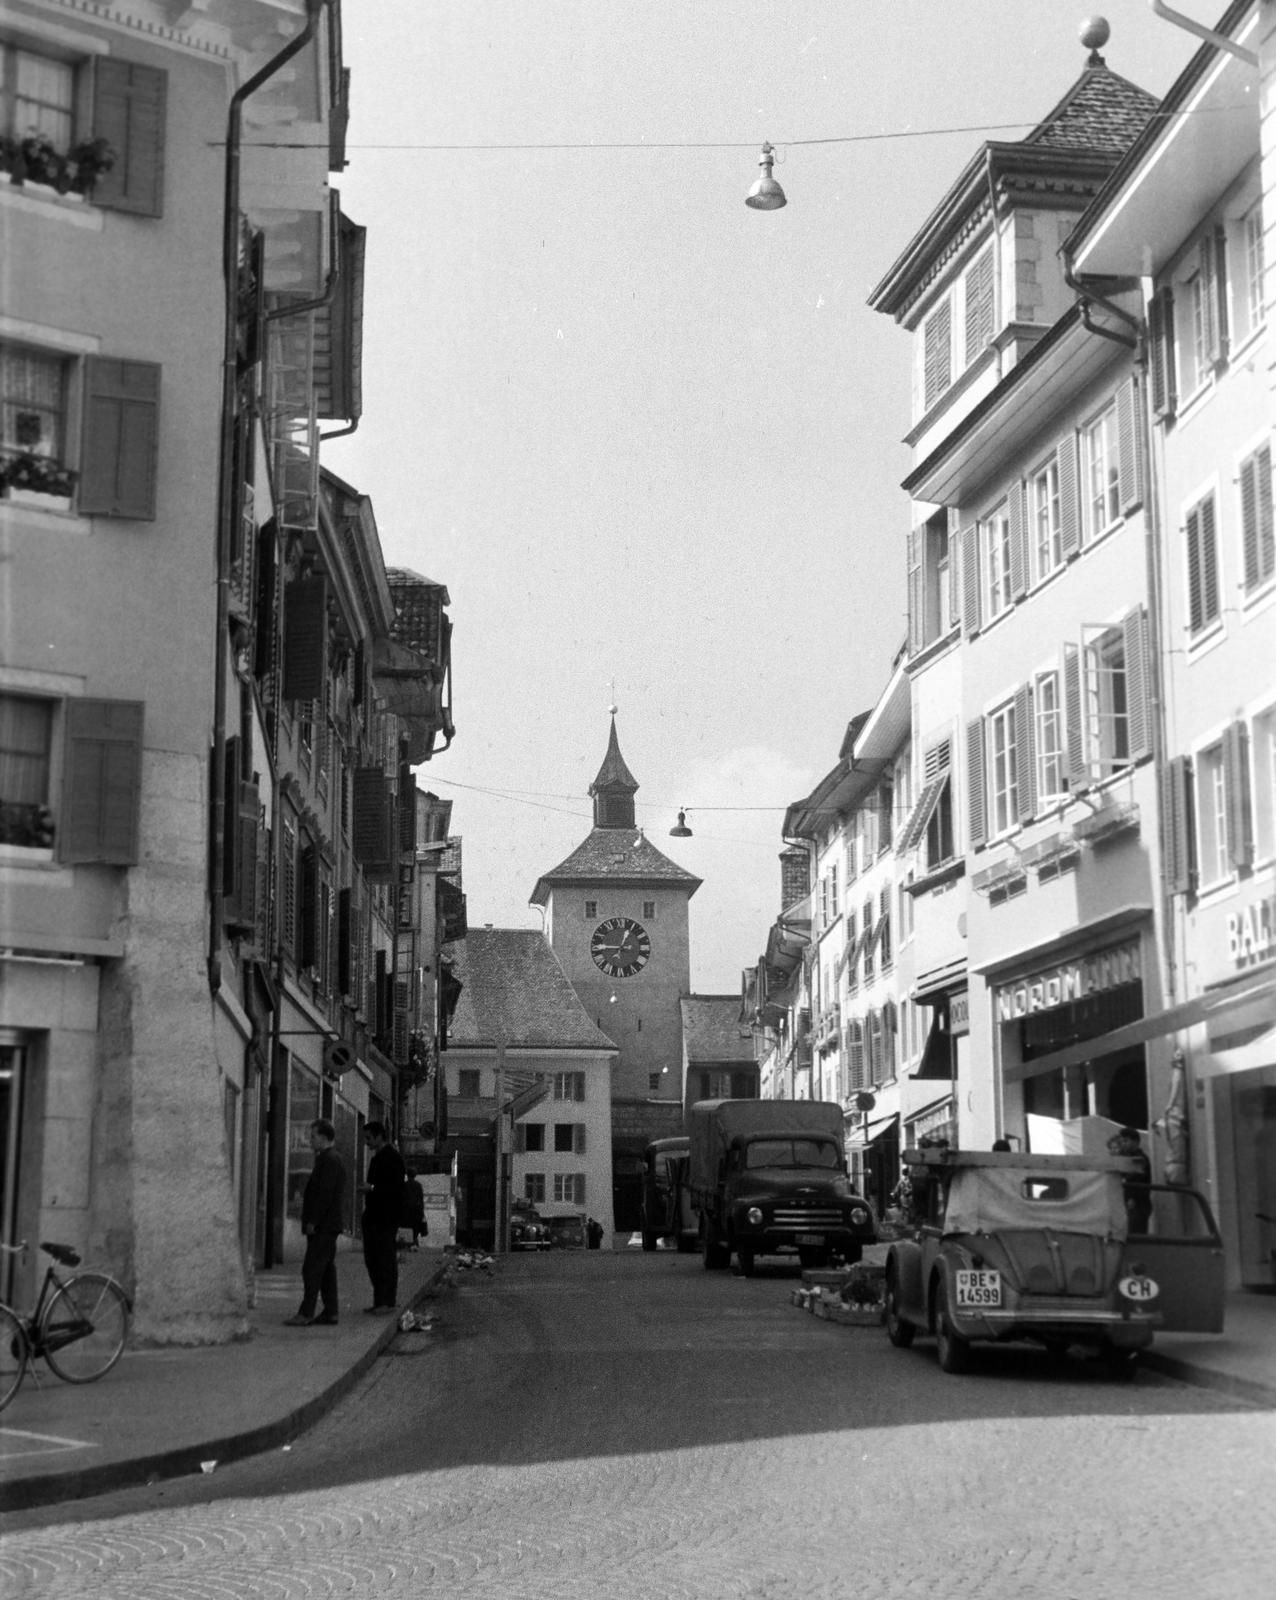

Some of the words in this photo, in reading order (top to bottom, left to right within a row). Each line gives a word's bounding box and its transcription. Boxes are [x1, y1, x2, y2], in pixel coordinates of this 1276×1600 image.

[970, 1272, 987, 1287] BE
[1127, 1274, 1151, 1297] CH
[959, 1287, 999, 1303] 14599
